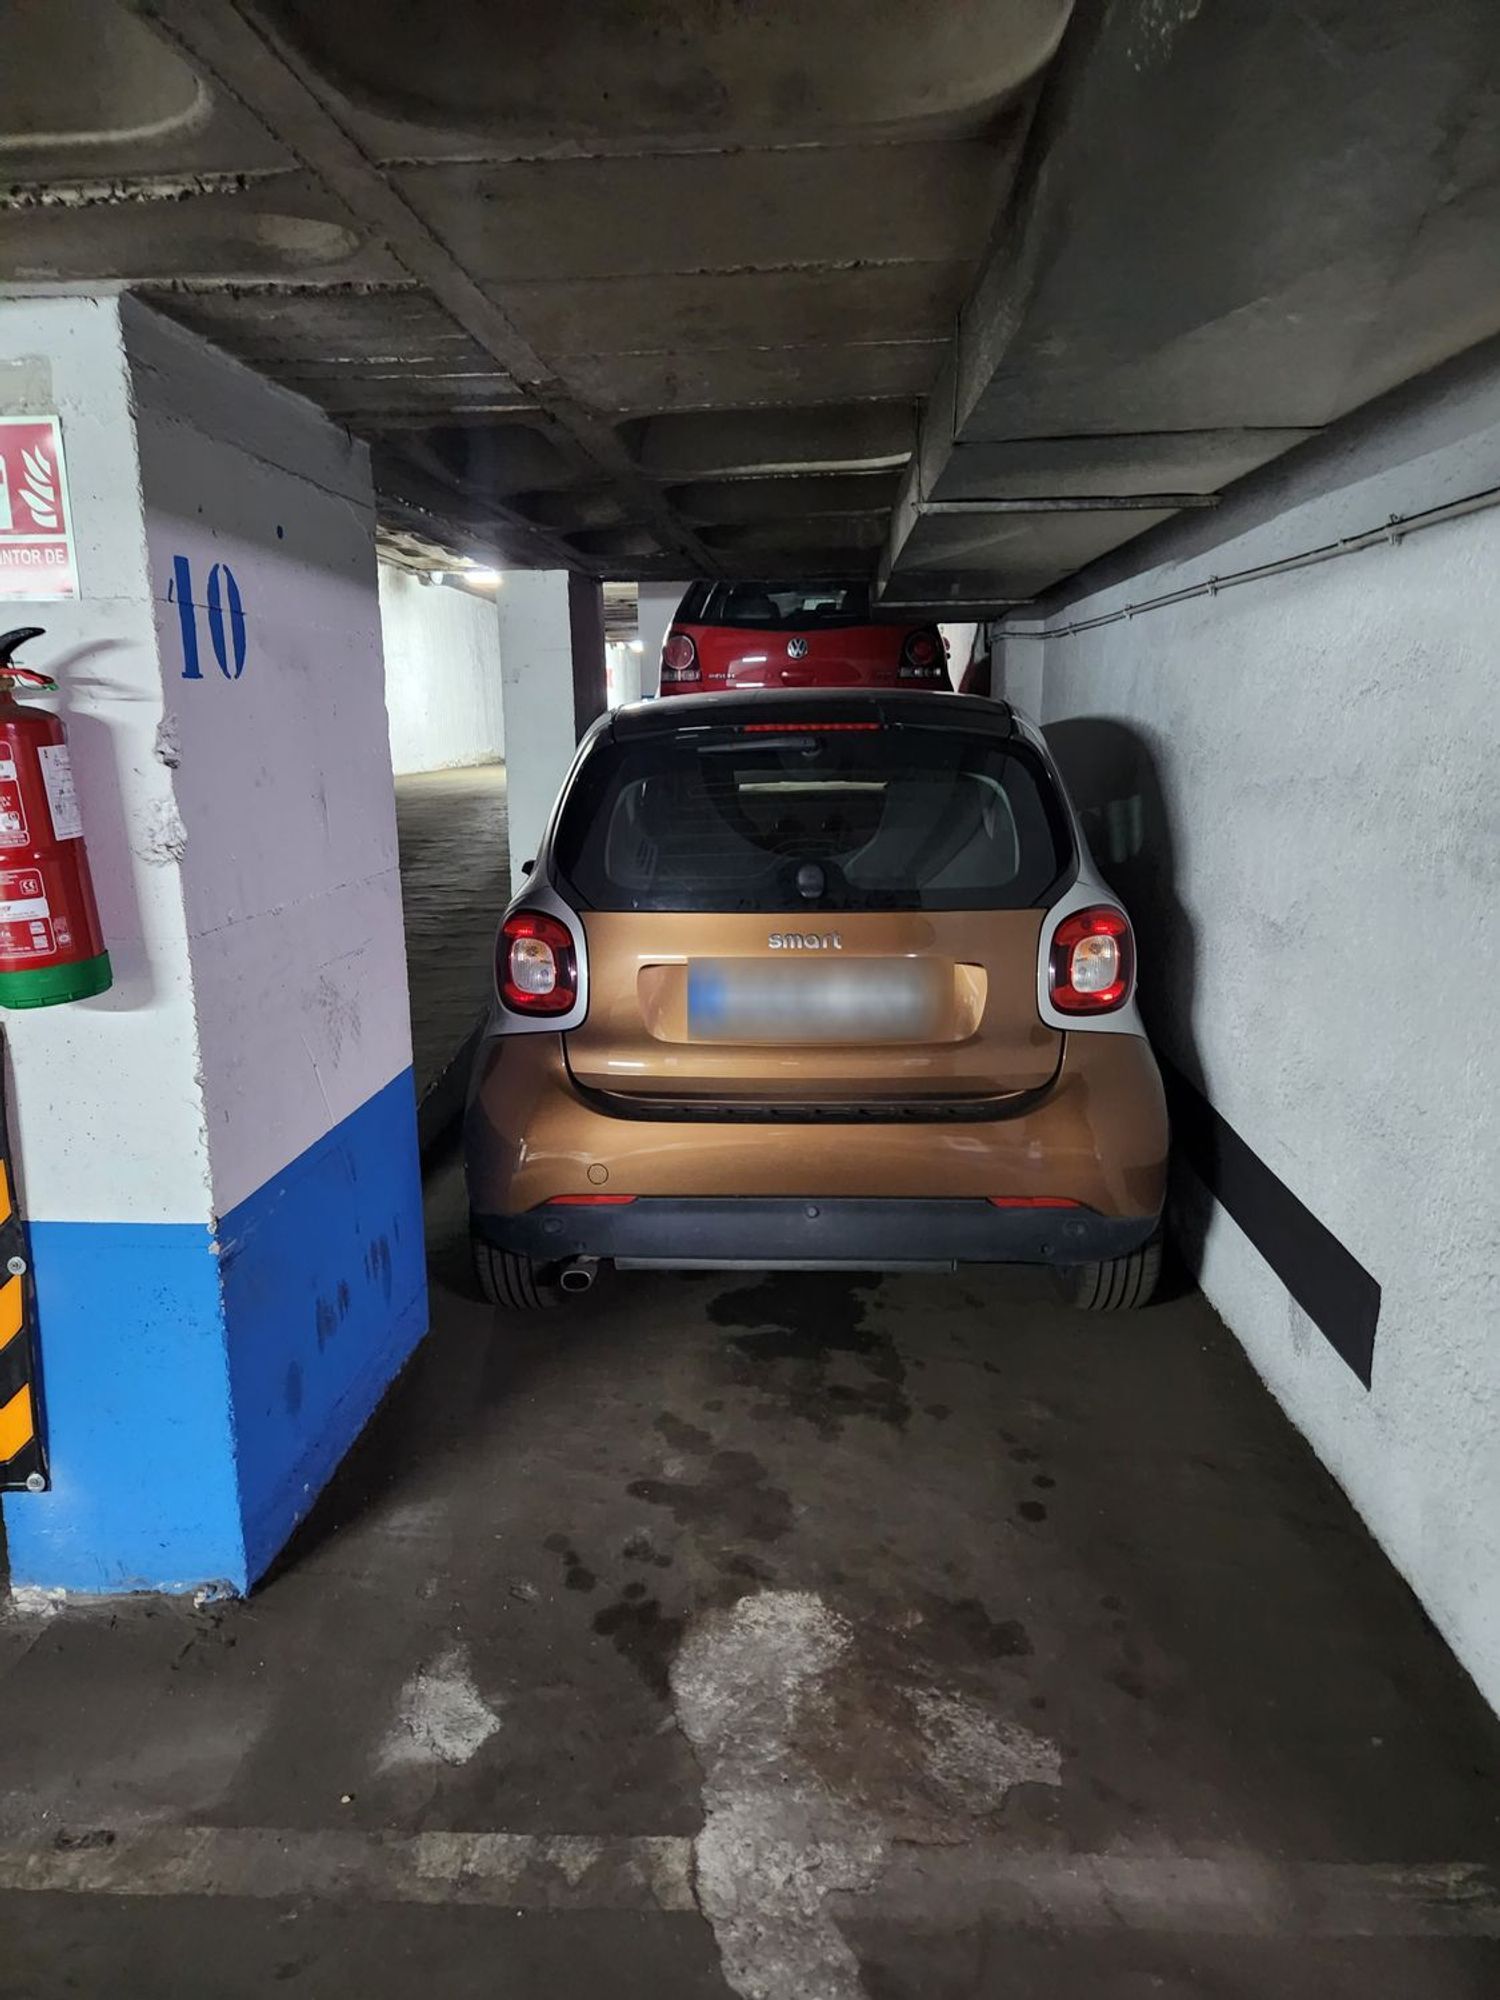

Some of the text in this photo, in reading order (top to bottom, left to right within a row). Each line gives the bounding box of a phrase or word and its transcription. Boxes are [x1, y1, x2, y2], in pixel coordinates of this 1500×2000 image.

[0, 548, 65, 565] NTOR DE
[168, 555, 247, 680] 10
[767, 929, 843, 950] smart
